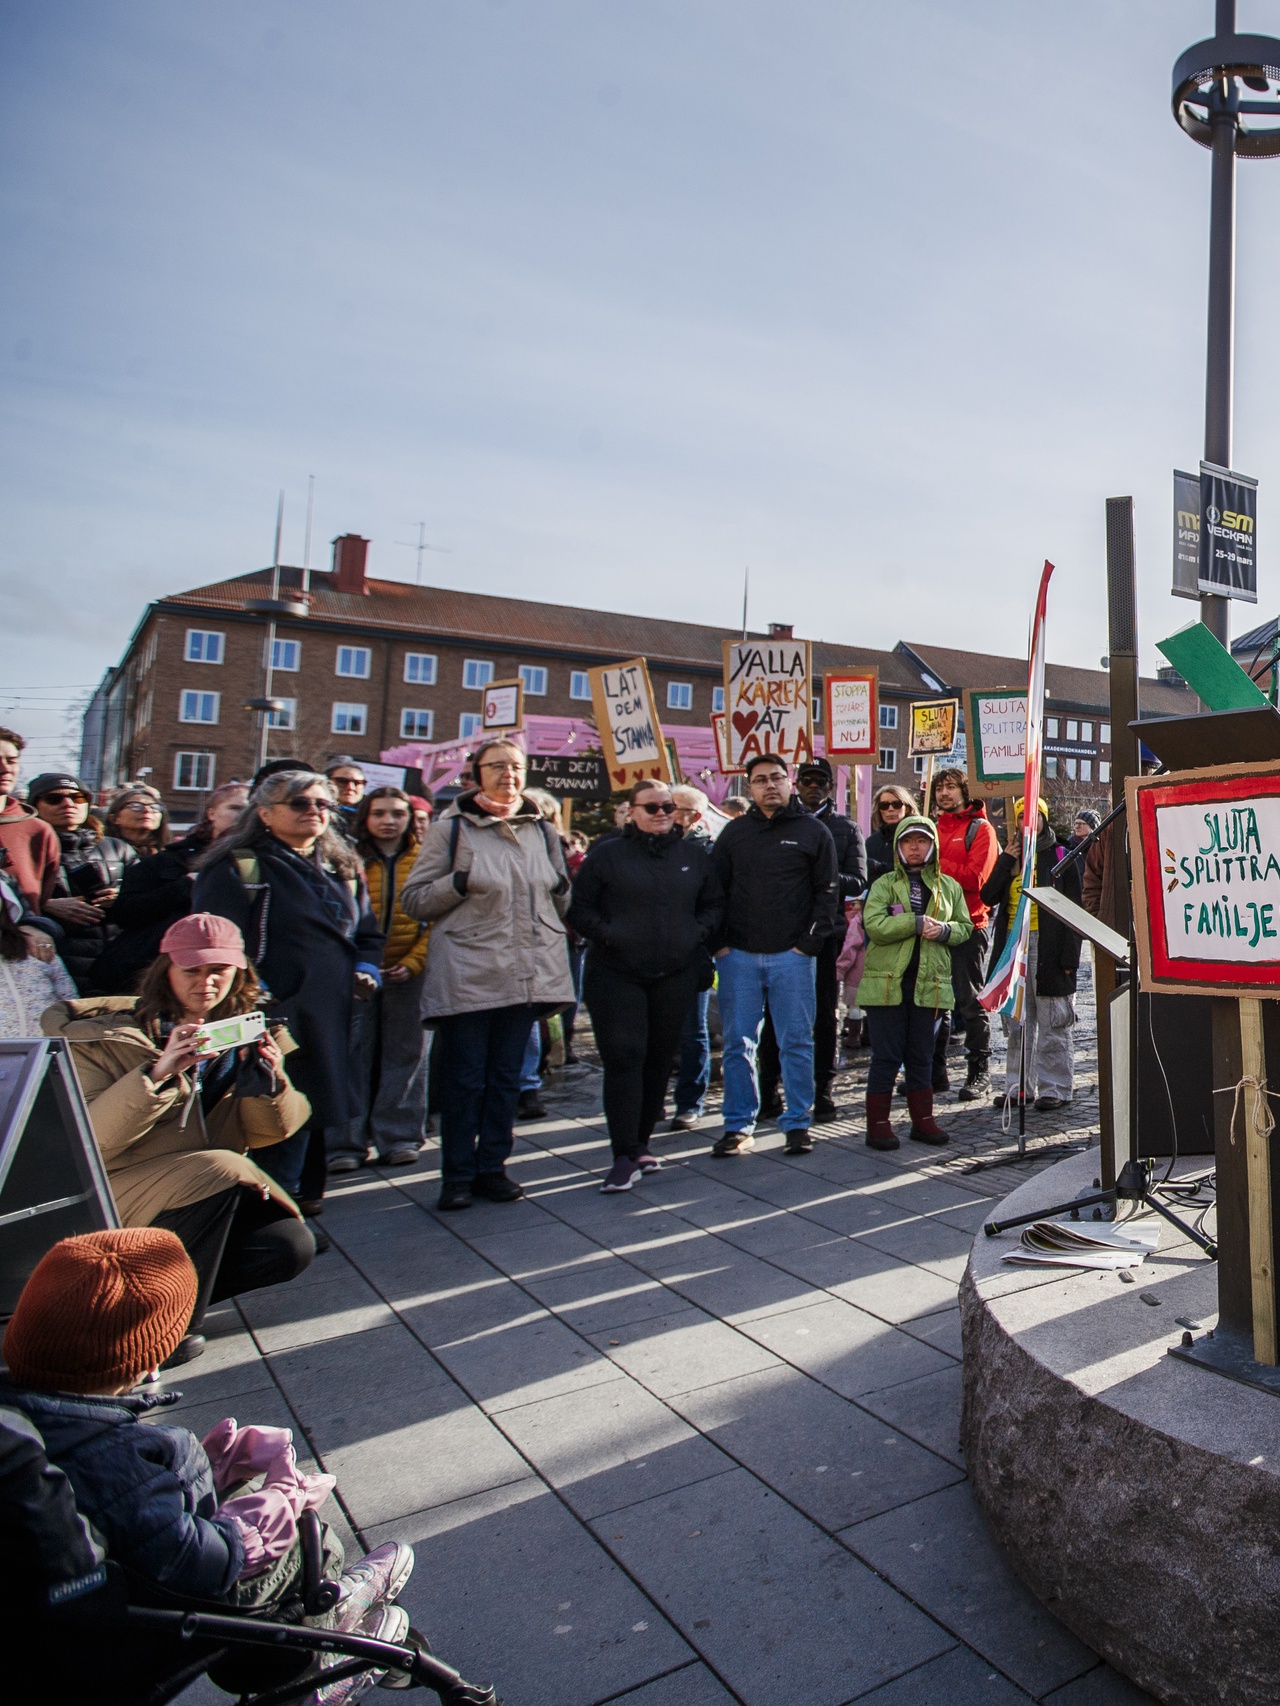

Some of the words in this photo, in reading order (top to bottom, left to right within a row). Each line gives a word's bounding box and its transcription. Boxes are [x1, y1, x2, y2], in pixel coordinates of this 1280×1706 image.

[1221, 509, 1254, 533] SM
[1206, 523, 1253, 545] VECKAN
[1236, 555, 1253, 566] mars
[729, 648, 805, 684] YALLA
[603, 667, 637, 698] LÅT
[834, 684, 868, 698] STOPPA
[735, 675, 808, 710] KÄRLEK
[615, 696, 643, 716] DEM
[920, 707, 949, 723] SLUTA
[983, 700, 1026, 715] SLUTA
[754, 705, 791, 734] ÅT
[840, 727, 866, 743] NU!
[738, 726, 814, 764] ALLA
[983, 742, 1026, 759] FAMILJE
[1043, 745, 1097, 756] AKADEMIBOKHANDELN
[531, 756, 561, 772] LÅT
[568, 760, 600, 774] DEM
[544, 776, 600, 790] STANNA!
[1199, 807, 1262, 855] SLUTA
